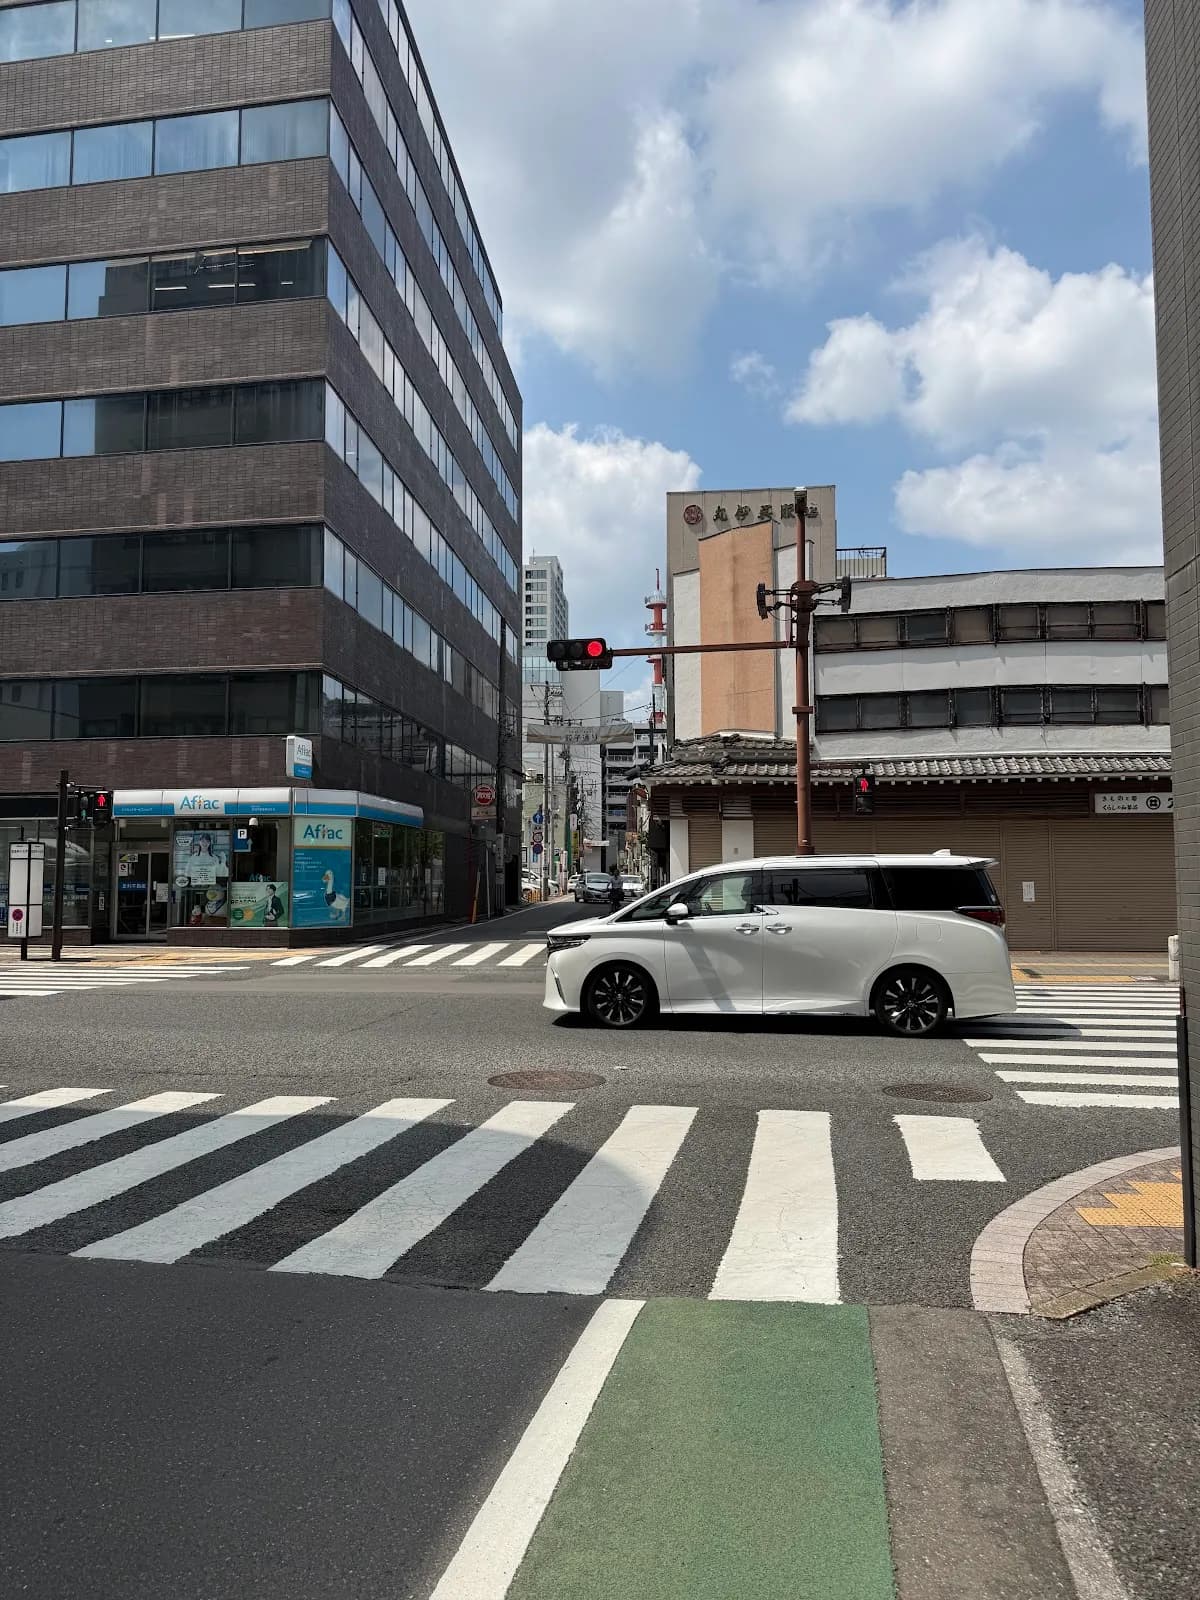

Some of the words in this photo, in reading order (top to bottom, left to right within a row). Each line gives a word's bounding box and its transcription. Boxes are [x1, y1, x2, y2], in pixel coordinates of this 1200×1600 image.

[180, 795, 220, 810] Aflac
[239, 830, 246, 838] P
[303, 824, 343, 840] Aflac
